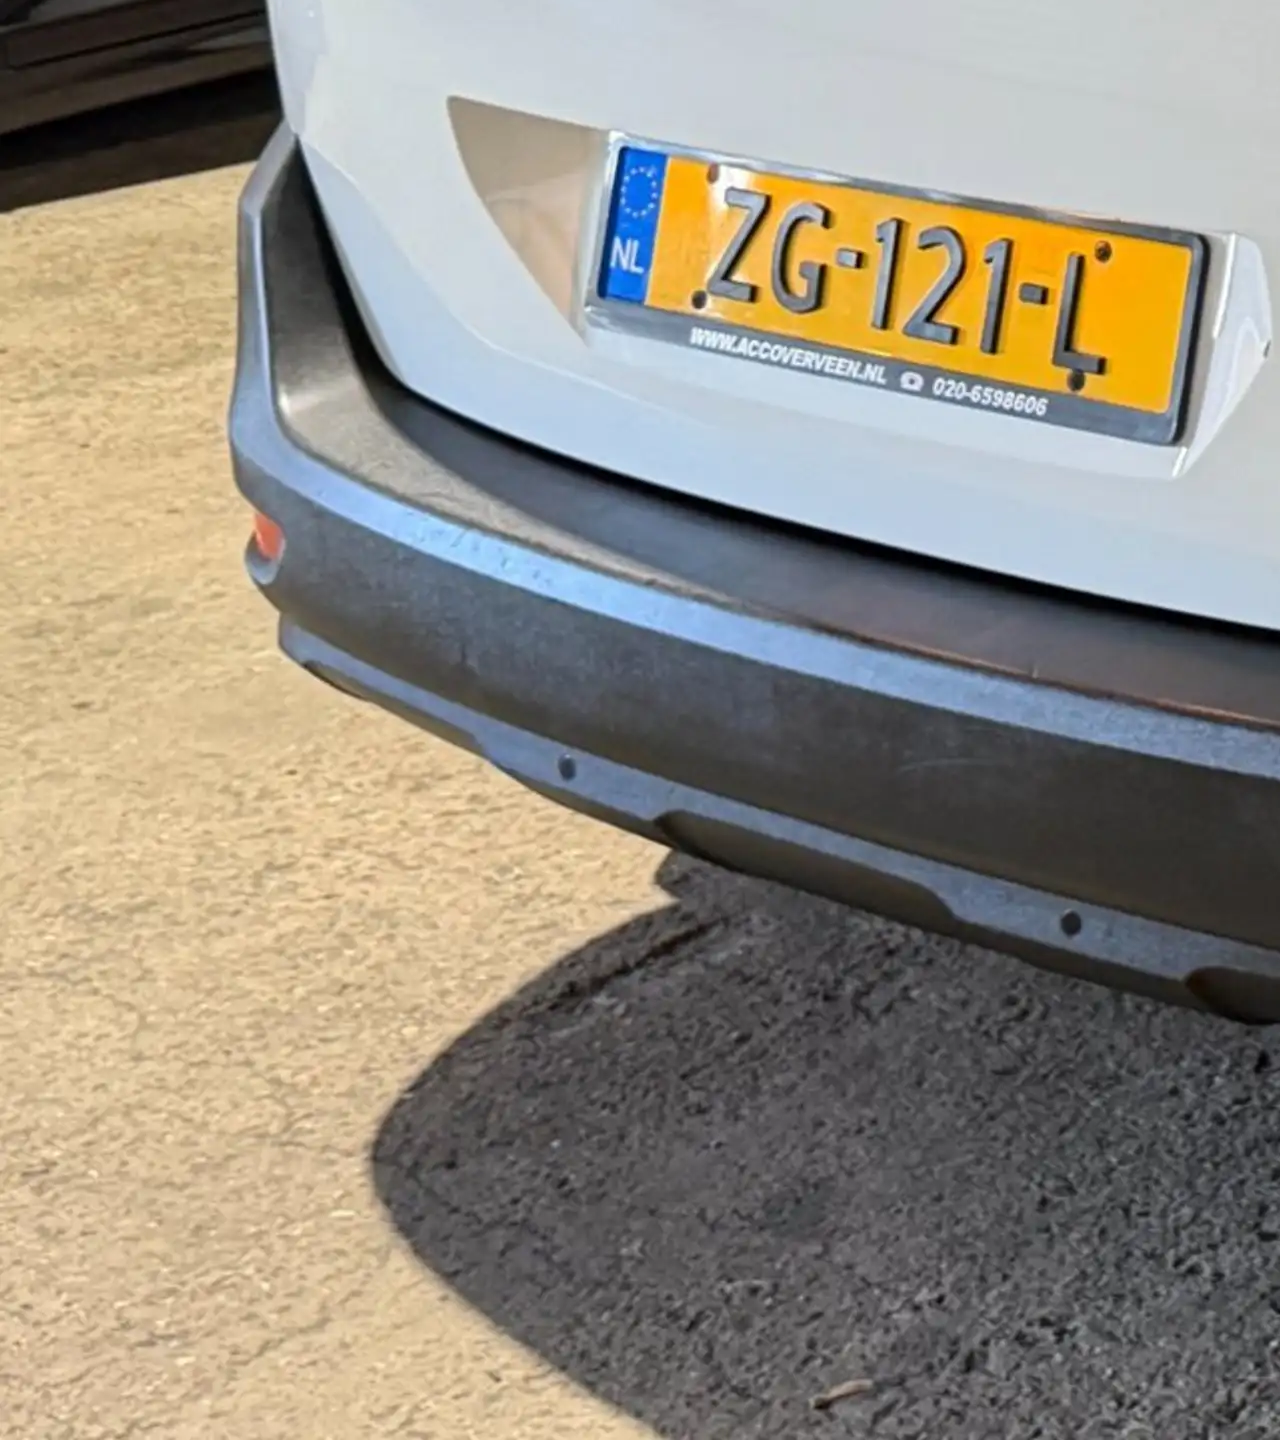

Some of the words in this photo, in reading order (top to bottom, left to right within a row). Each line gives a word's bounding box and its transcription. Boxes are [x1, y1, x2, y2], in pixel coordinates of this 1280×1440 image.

[609, 235, 645, 274] NL
[705, 188, 1106, 375] ZG-121-L
[689, 326, 887, 385] WWW.ACCOVERVEEN.NL
[931, 377, 1048, 417] 020-6598606
